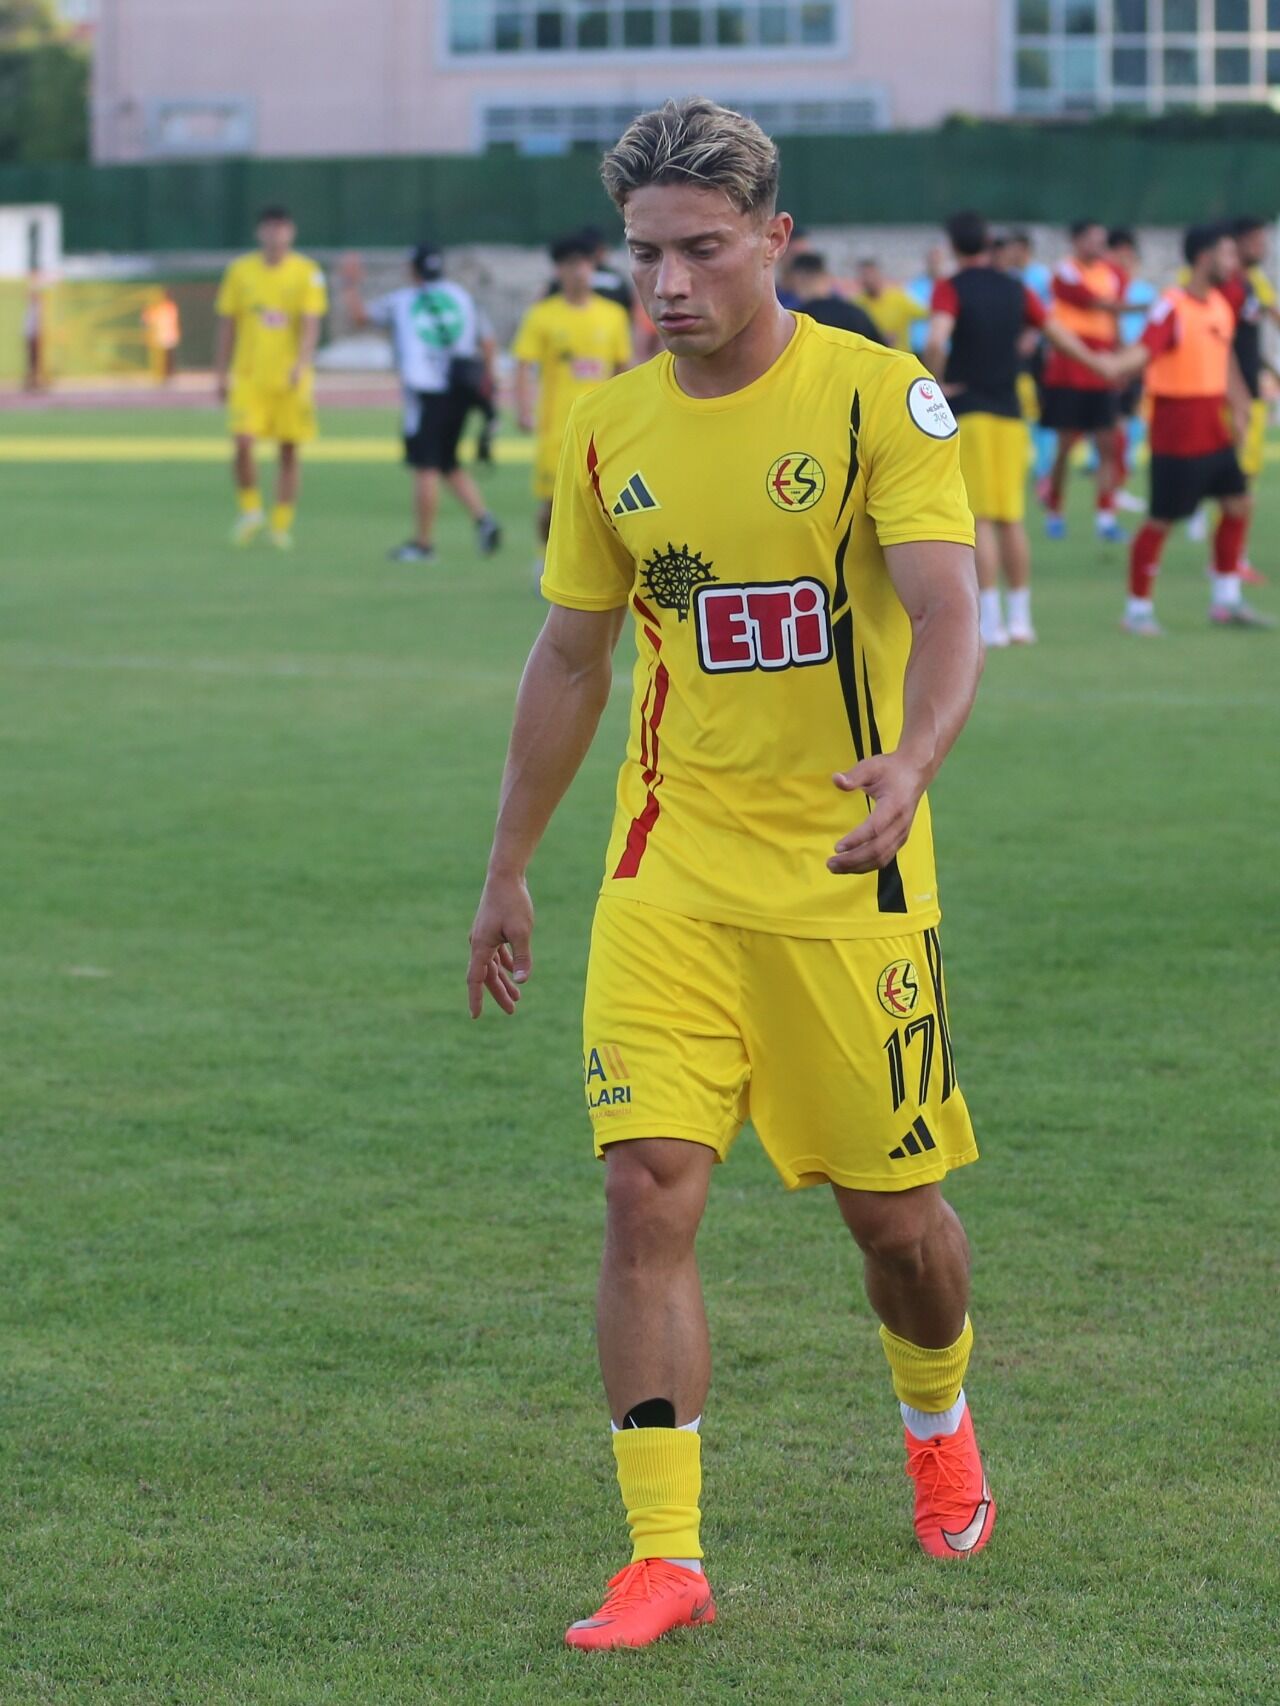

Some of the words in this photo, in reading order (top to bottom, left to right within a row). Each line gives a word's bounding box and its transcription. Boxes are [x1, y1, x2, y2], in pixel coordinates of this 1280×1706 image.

[585, 1047, 607, 1084] A
[882, 1013, 935, 1114] 17
[588, 1085, 631, 1110] LARI
